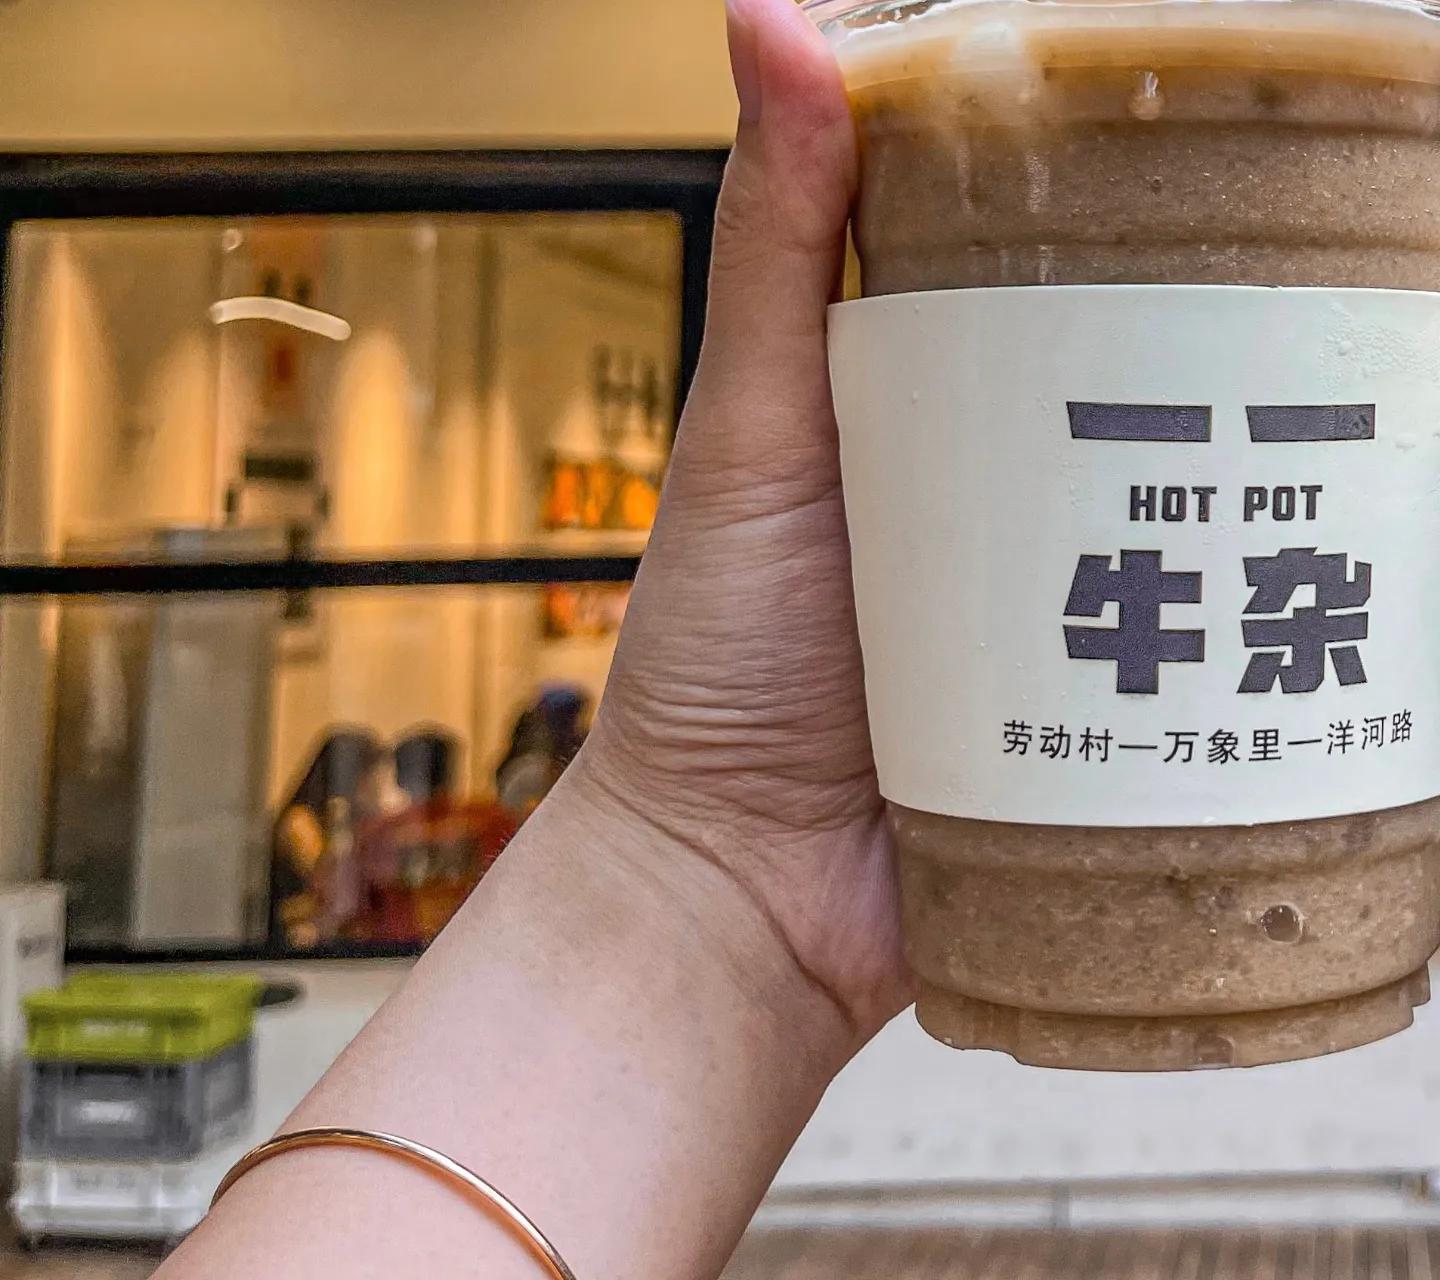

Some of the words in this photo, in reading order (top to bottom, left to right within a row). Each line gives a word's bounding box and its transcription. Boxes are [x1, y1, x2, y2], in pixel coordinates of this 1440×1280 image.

[1129, 485, 1217, 522] HOT
[1243, 485, 1323, 522] POT
[1063, 547, 1372, 695] 牛杂
